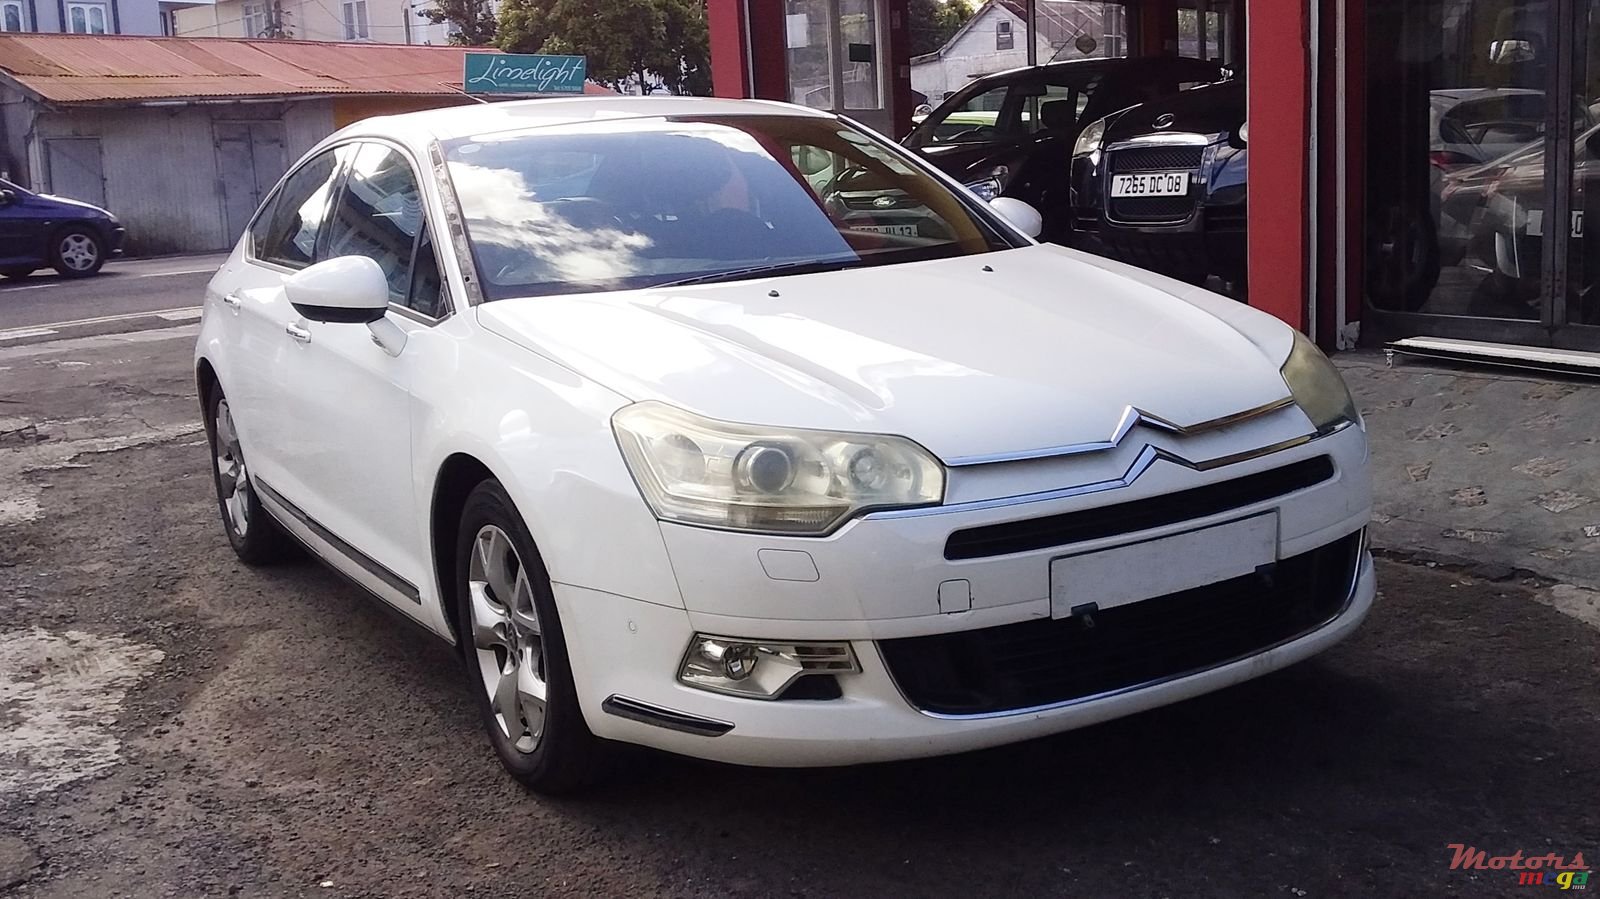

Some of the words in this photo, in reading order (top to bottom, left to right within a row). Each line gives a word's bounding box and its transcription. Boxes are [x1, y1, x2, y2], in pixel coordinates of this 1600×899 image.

[468, 56, 583, 91] Limelight
[1119, 176, 1146, 194] 7265
[1149, 176, 1163, 193] DC
[1166, 175, 1182, 192] 08
